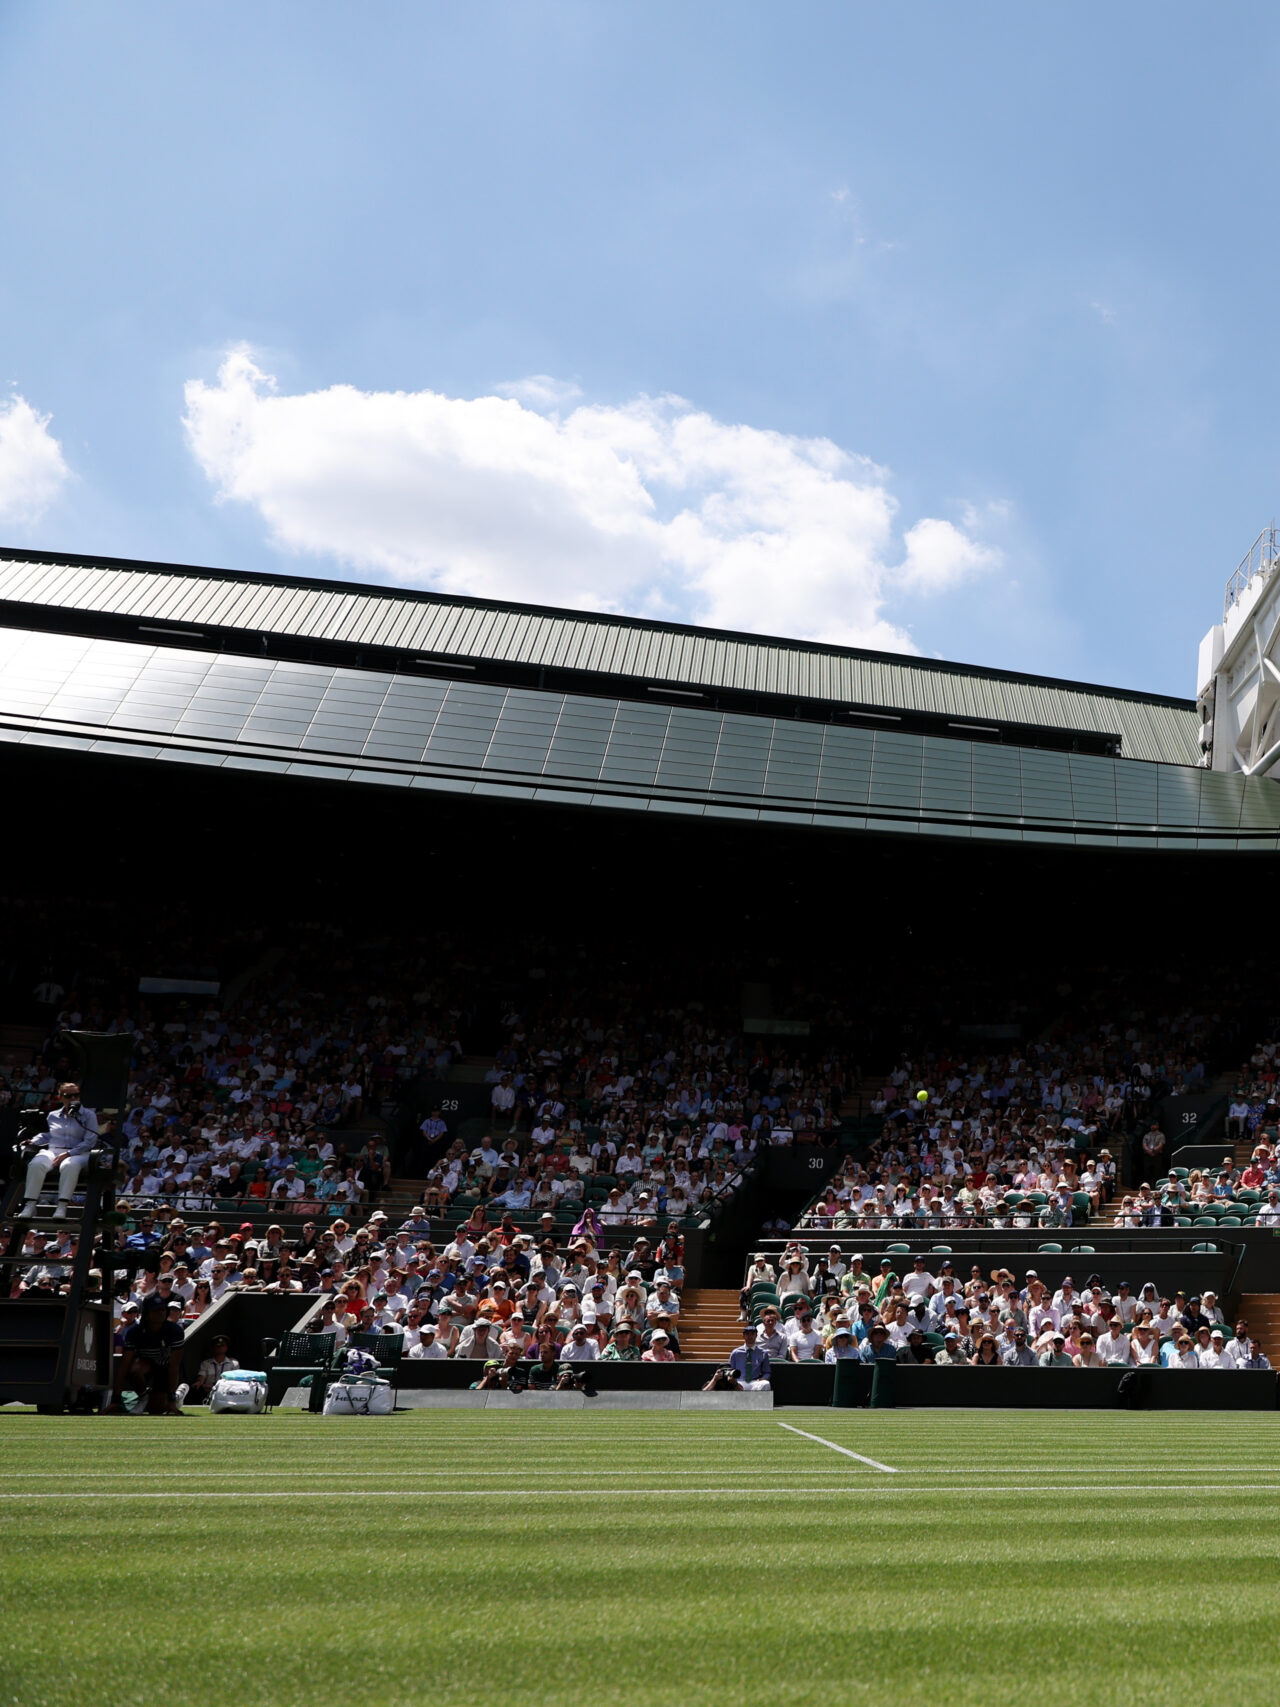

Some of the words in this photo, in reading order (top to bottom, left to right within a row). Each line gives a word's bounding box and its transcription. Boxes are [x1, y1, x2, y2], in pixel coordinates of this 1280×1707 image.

[441, 1099, 459, 1111] 28
[1182, 1112, 1197, 1124] 32
[808, 1157, 824, 1169] 30
